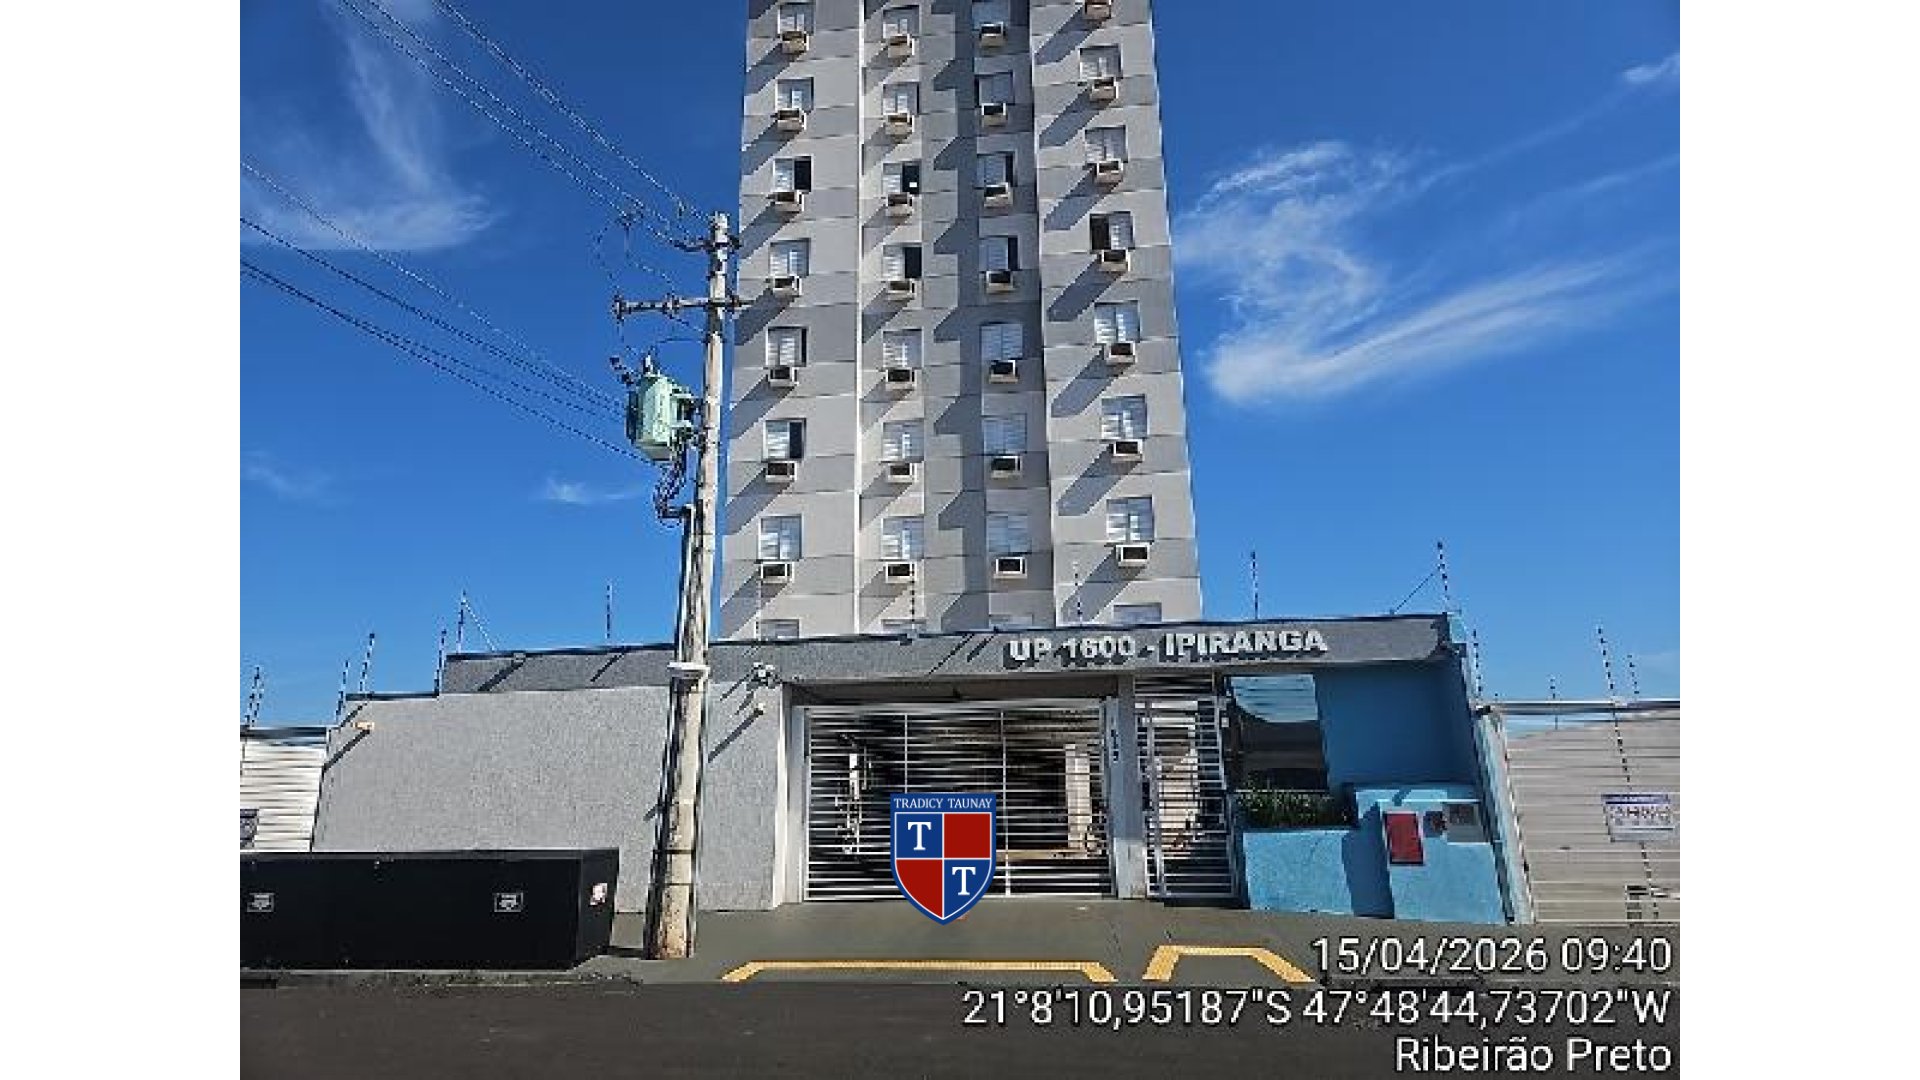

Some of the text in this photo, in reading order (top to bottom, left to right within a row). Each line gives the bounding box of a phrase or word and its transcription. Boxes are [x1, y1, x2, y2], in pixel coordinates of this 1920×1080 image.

[1009, 638, 1050, 661] UP
[1064, 635, 1136, 659] 1600
[1163, 630, 1328, 657] IPIRANGA
